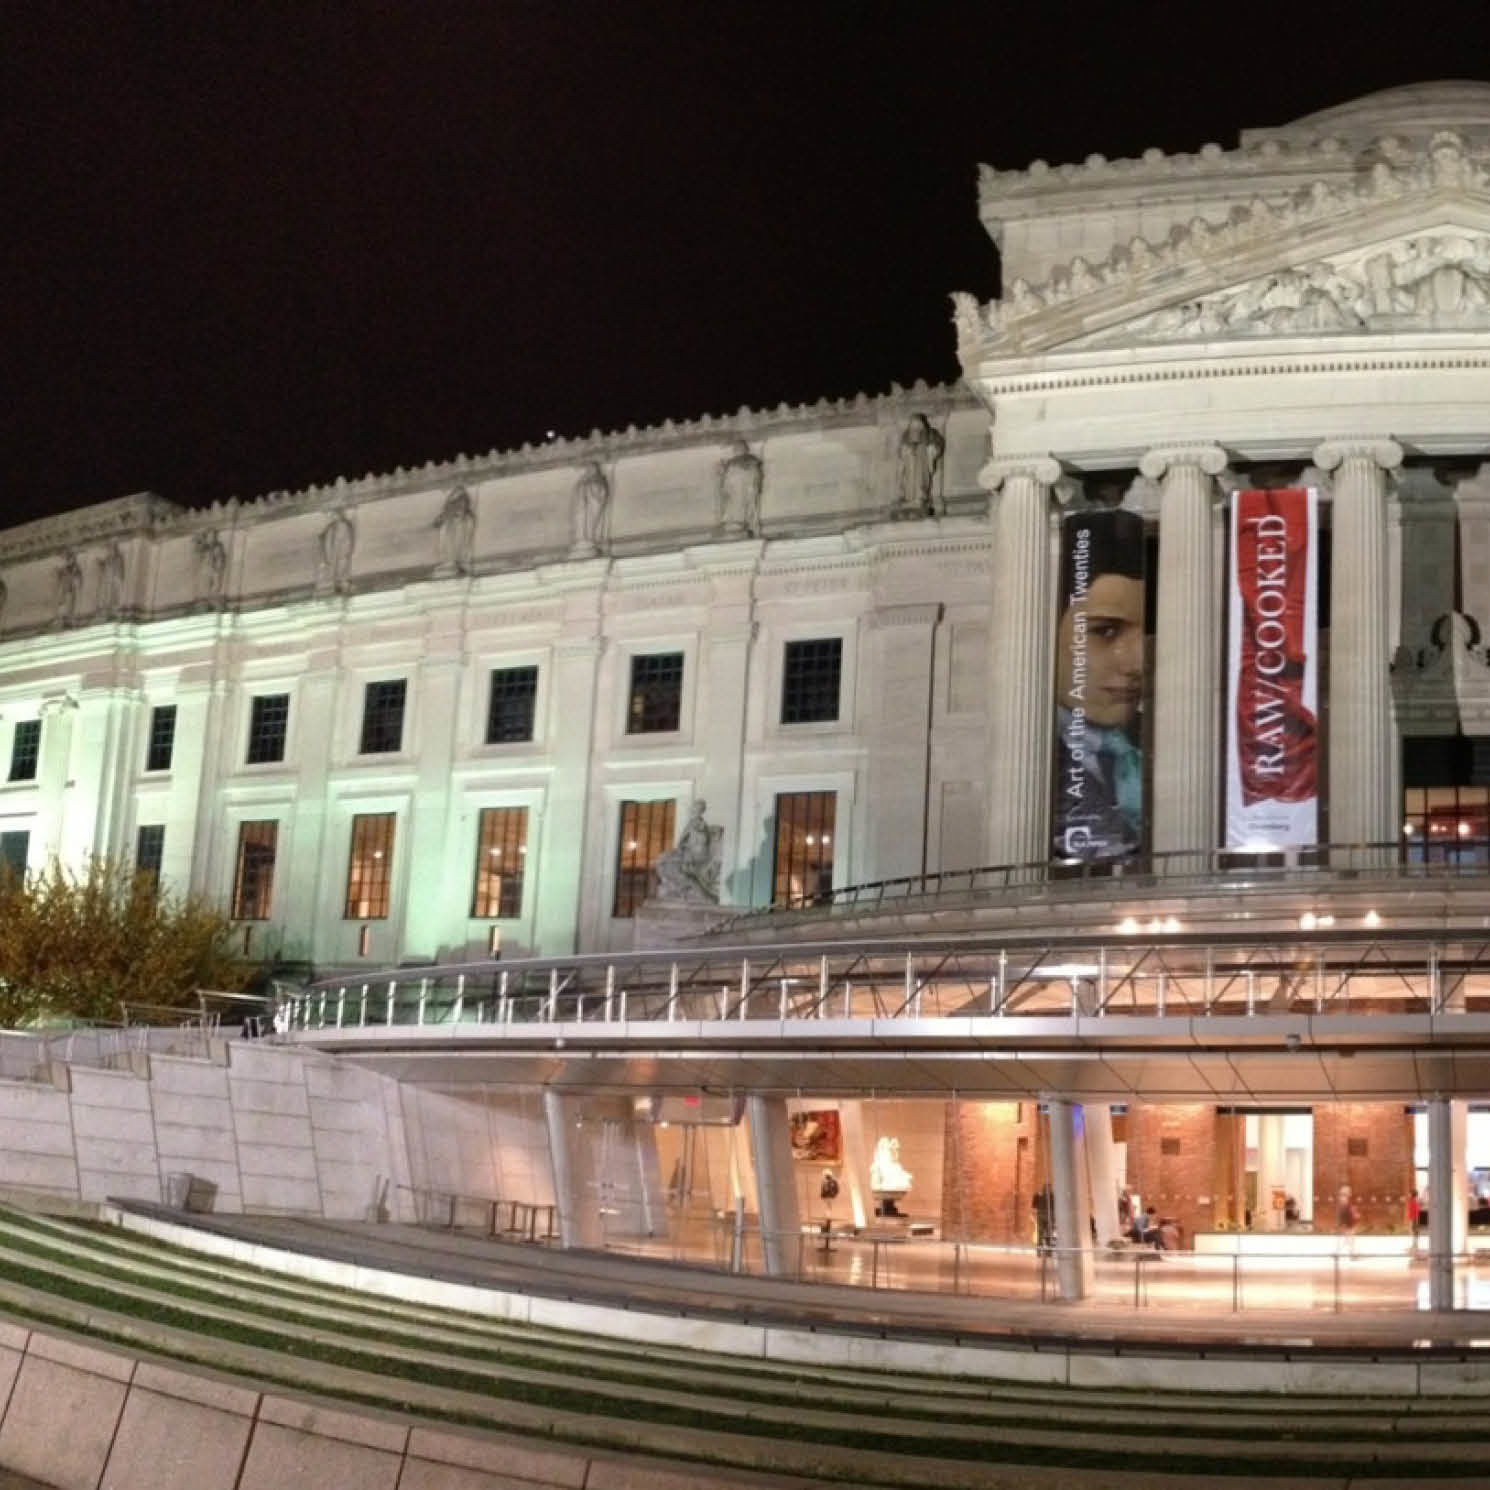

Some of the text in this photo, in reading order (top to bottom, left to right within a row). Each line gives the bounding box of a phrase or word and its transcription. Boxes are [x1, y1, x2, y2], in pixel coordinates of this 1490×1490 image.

[1067, 529, 1091, 798] Art of the American Twenties
[1252, 514, 1288, 776] RAW/COOKED
